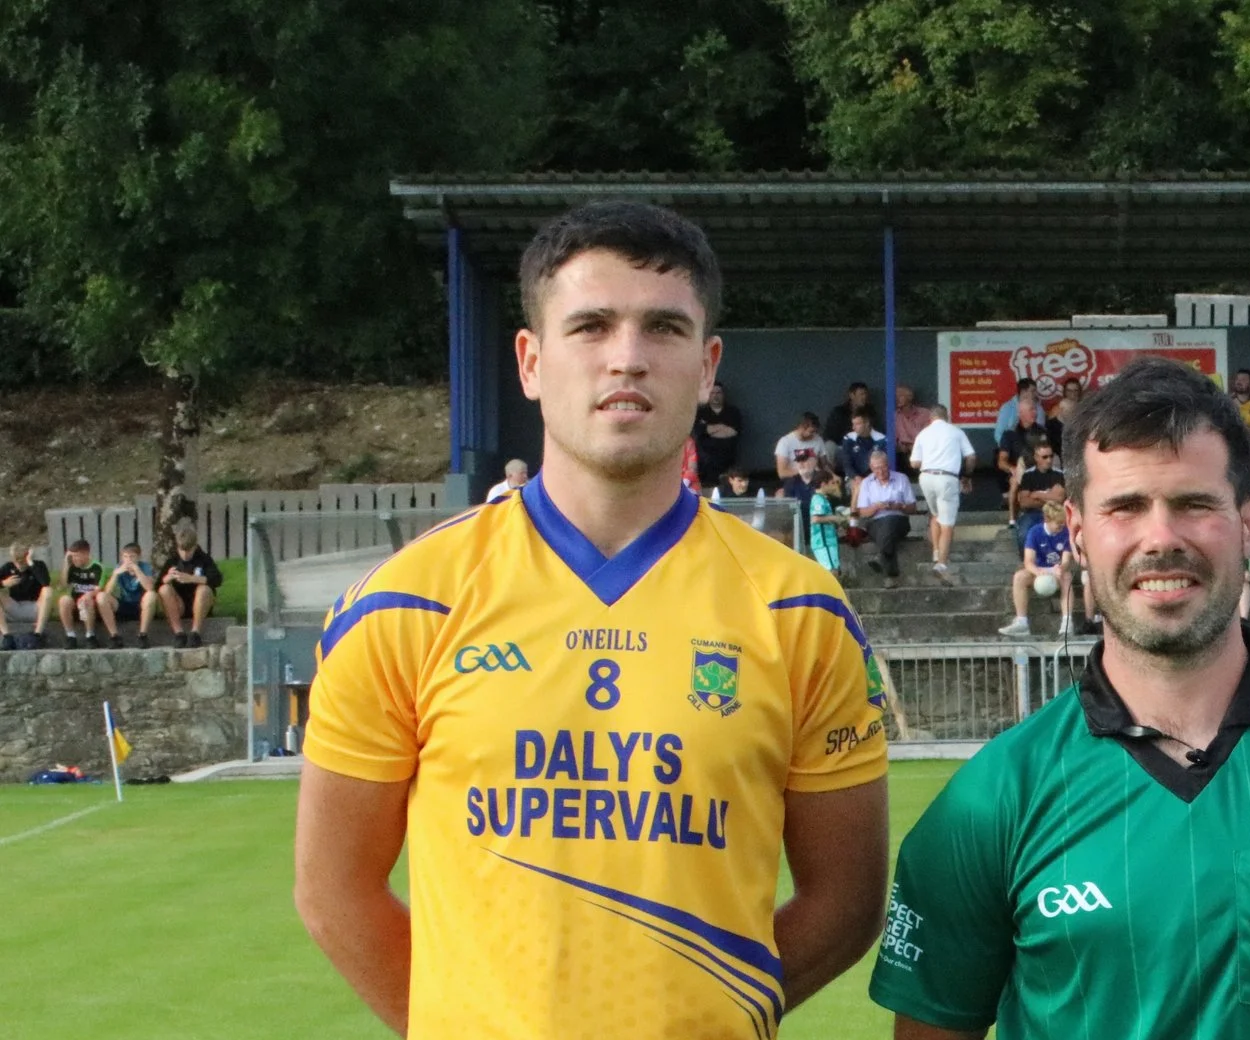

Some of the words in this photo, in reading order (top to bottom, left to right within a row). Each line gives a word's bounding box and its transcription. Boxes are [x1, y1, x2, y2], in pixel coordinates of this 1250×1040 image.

[1014, 349, 1088, 381] free
[566, 628, 648, 652] O'NEILLS
[690, 638, 727, 649] CUMANN
[728, 643, 743, 653] SPA
[585, 658, 621, 711] 8
[514, 729, 683, 784] DALY'S
[825, 726, 860, 755] SPA
[467, 786, 729, 849] SUPERVALU
